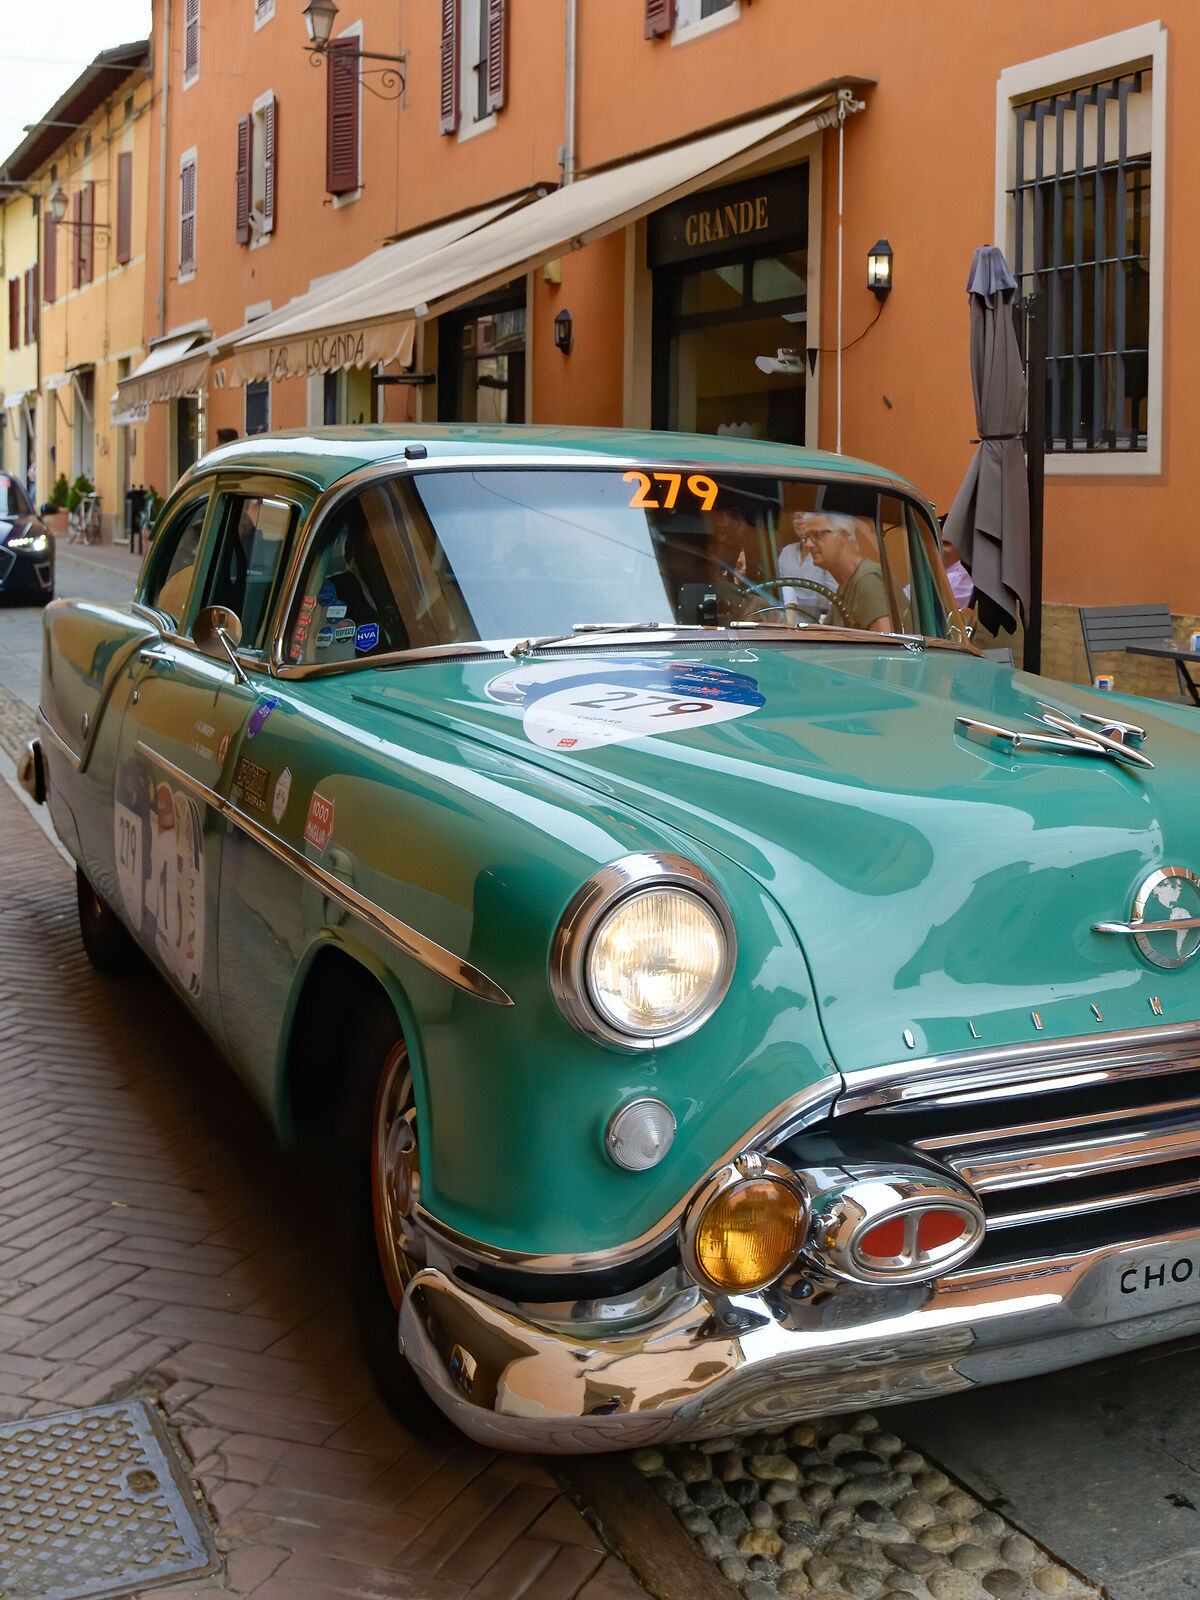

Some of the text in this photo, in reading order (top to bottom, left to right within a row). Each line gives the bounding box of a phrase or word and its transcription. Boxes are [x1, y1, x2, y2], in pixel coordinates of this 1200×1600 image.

[685, 196, 769, 246] GRANDE
[306, 332, 364, 371] LOCANDA
[622, 471, 719, 511] 279
[357, 631, 376, 641] HVA
[569, 691, 714, 718] 279
[312, 799, 330, 823] 1000
[119, 815, 137, 875] 279
